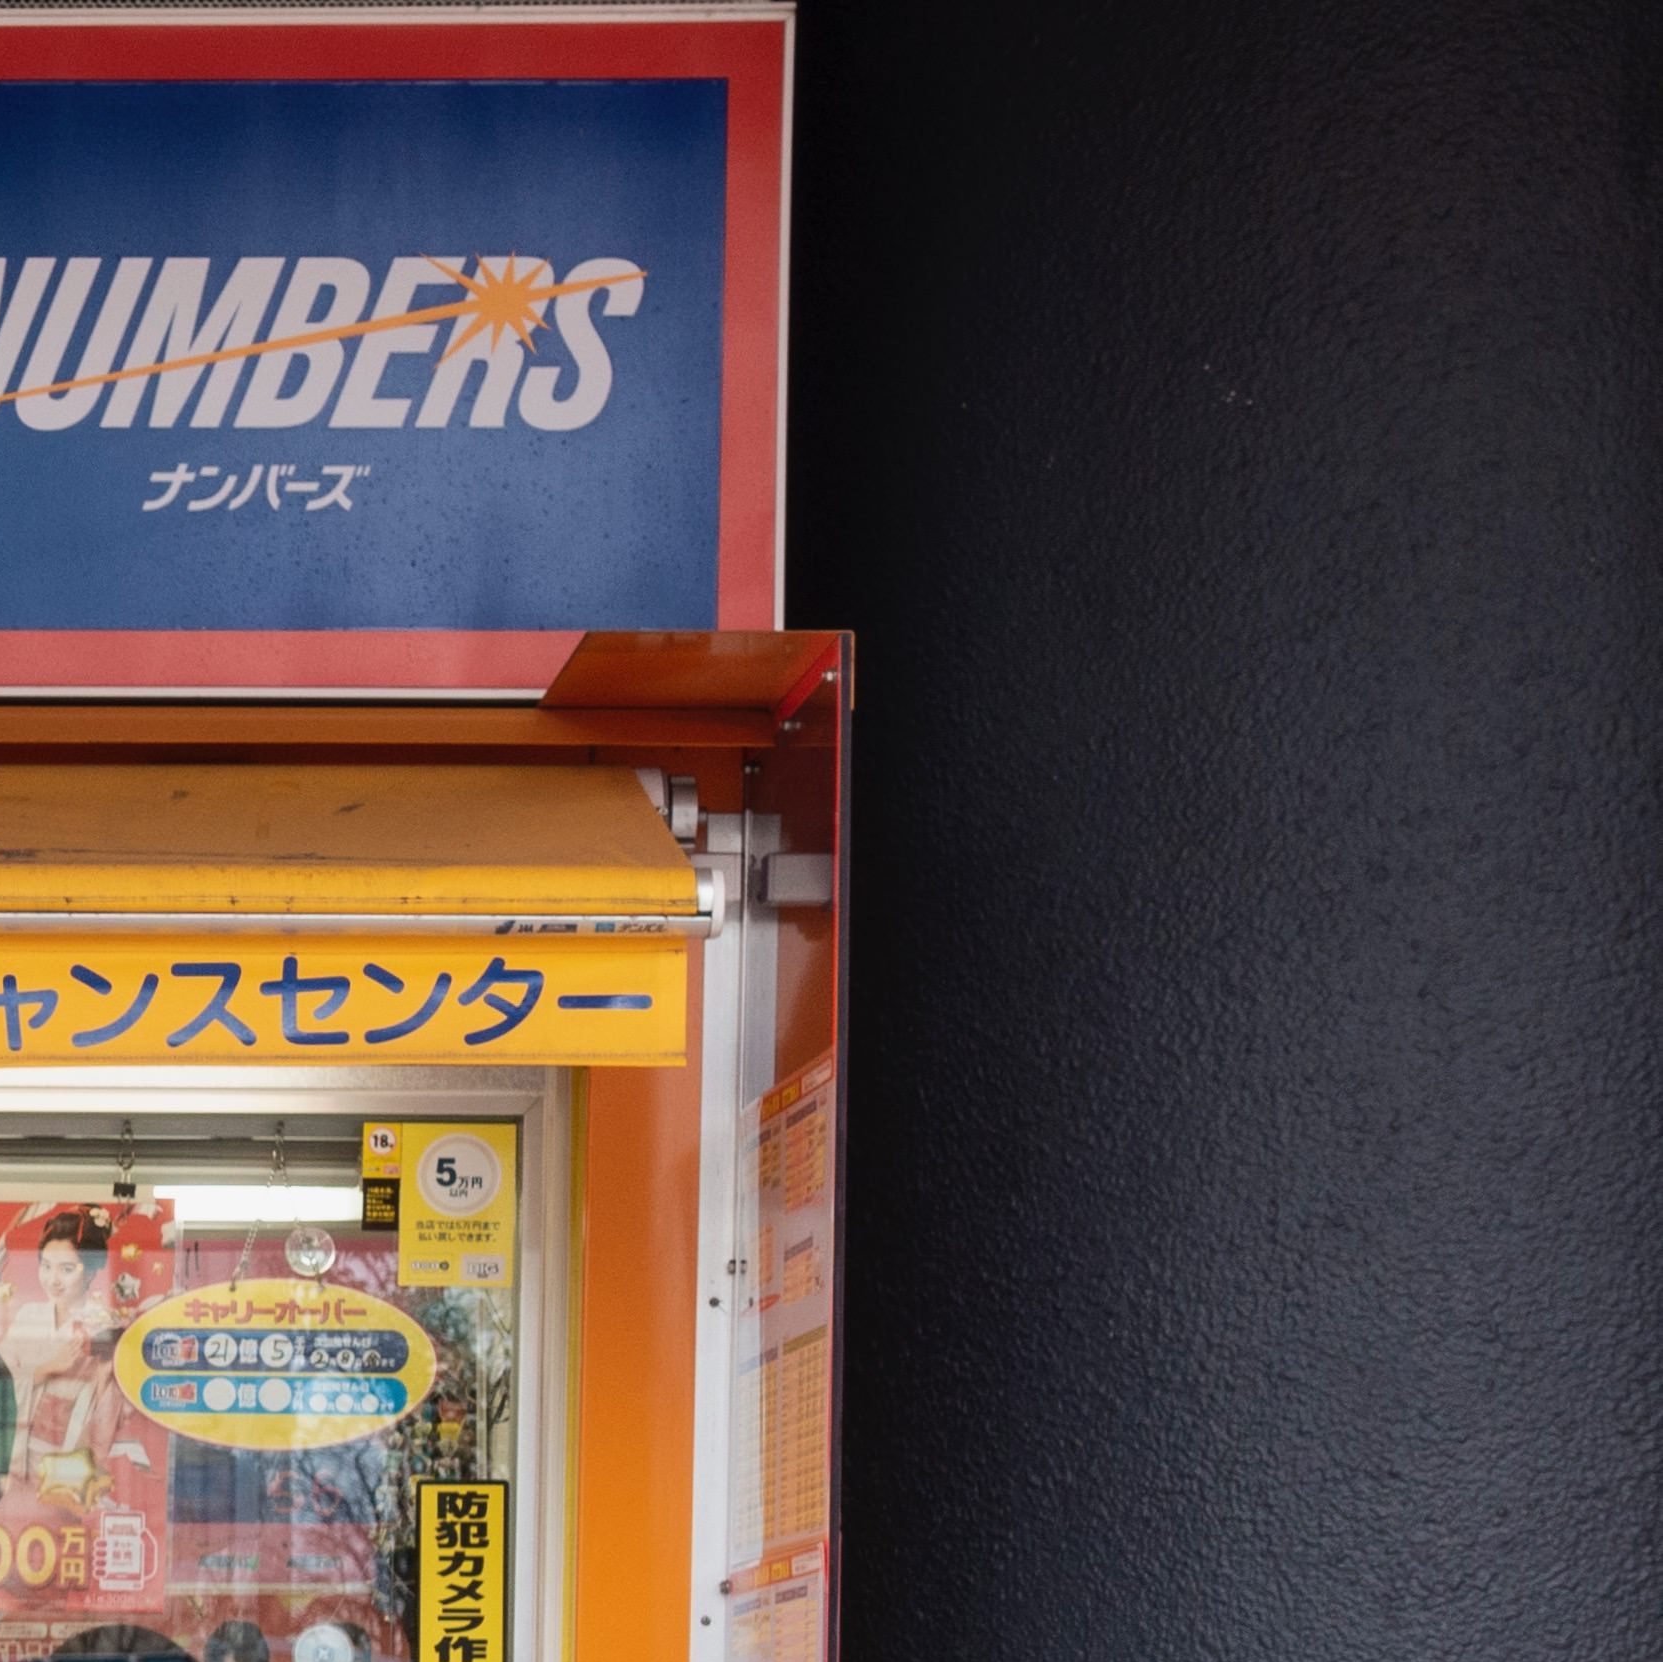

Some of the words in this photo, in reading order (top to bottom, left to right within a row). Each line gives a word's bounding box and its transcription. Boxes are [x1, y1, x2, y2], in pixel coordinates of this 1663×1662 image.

[142, 462, 370, 511] ナンバーズ
[435, 1157, 483, 1190] 5万円
[183, 1299, 367, 1324] キャリーオーバー
